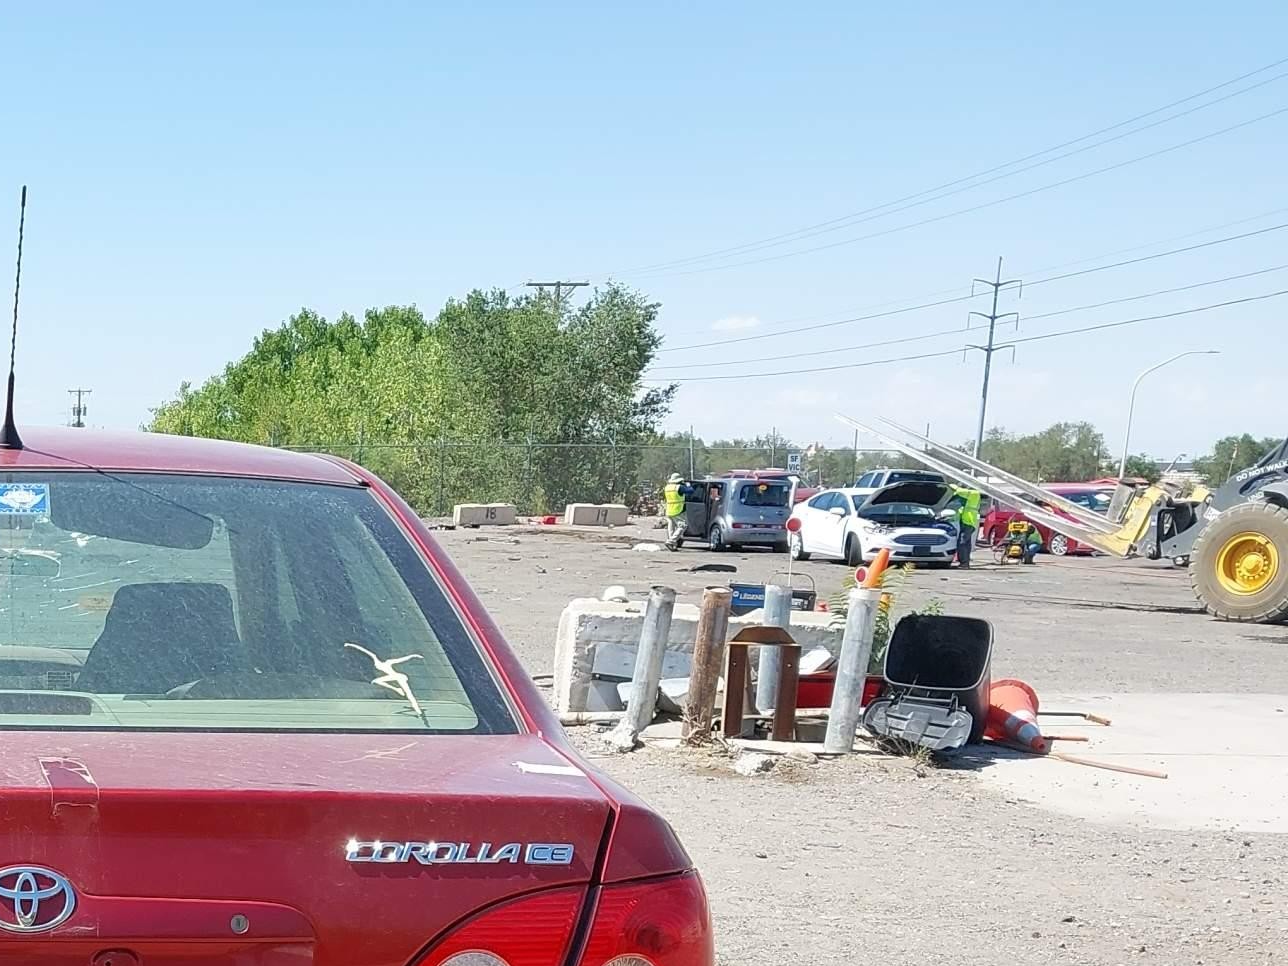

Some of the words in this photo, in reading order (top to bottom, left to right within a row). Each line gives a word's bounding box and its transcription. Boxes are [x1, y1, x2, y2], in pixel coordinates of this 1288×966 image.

[1236, 472, 1248, 482] DO
[1249, 467, 1266, 477] NOT
[346, 840, 522, 865] COROLLA
[527, 844, 573, 864] CE
